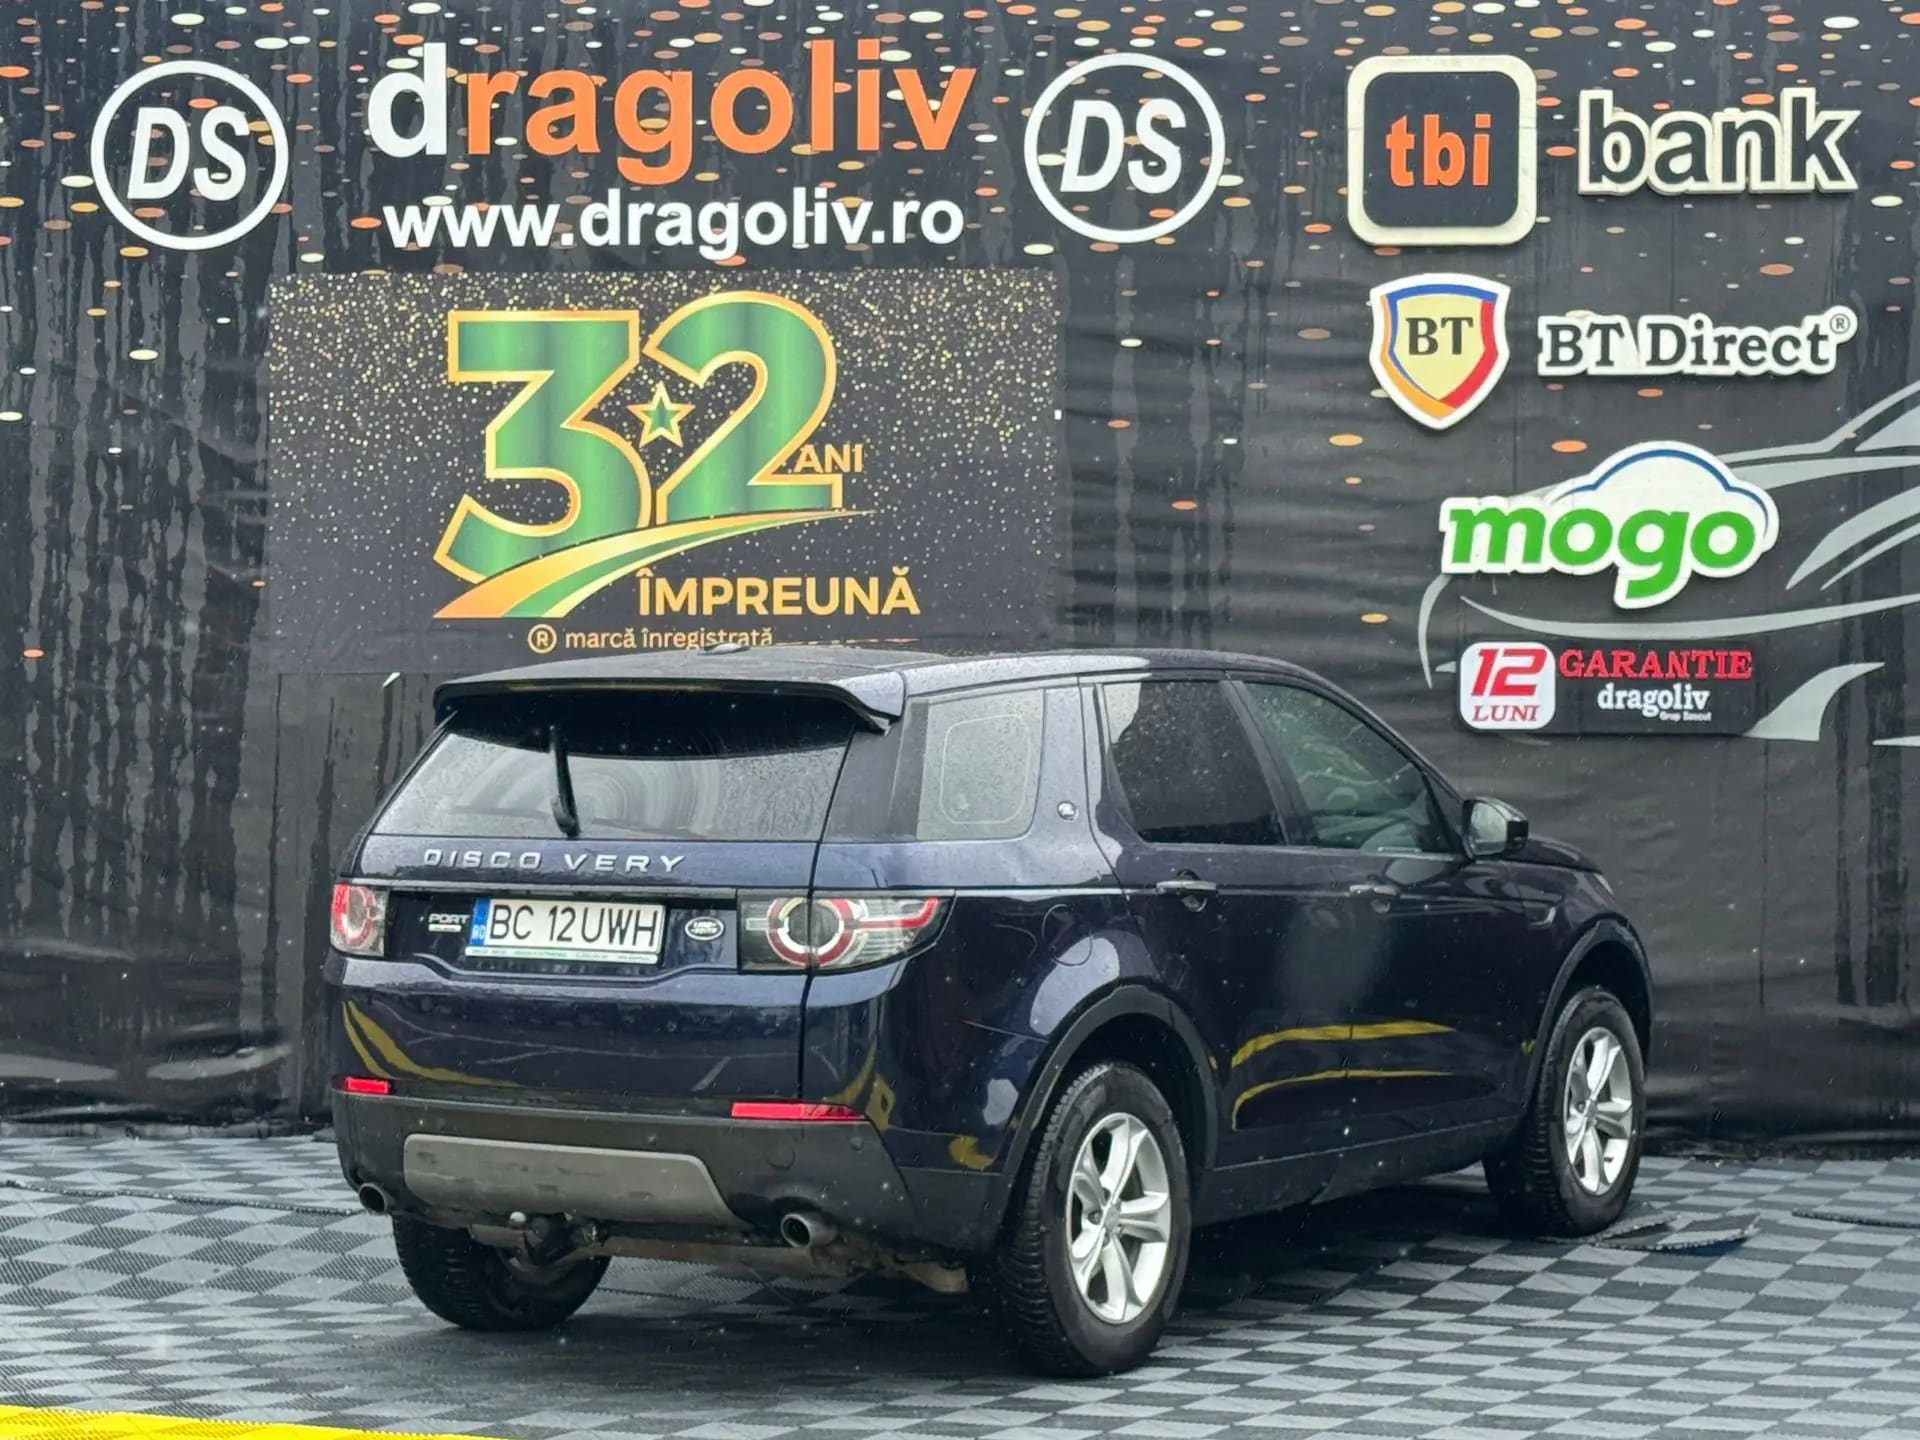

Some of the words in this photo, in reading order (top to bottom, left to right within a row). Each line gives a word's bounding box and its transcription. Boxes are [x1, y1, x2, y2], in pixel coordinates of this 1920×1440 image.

[368, 39, 976, 185] dragoliv
[127, 106, 251, 201] DS
[1060, 98, 1186, 194] DS
[1385, 113, 1491, 188] tbi
[1583, 90, 1857, 192] bank
[383, 187, 964, 262] www.dragoliv.ro
[1406, 317, 1474, 355] BT
[1546, 321, 1625, 367] BT
[433, 291, 843, 584] 32
[794, 443, 863, 474] ANI
[1449, 507, 1756, 599] mogo
[637, 566, 920, 616] ÎMPREUNĂ
[565, 628, 637, 648] marcă
[1471, 647, 1547, 696] 12
[1559, 648, 1753, 679] GARANTIE
[1472, 705, 1540, 722] LUNI
[1598, 682, 1710, 717] dragoliv
[490, 904, 534, 939] BC
